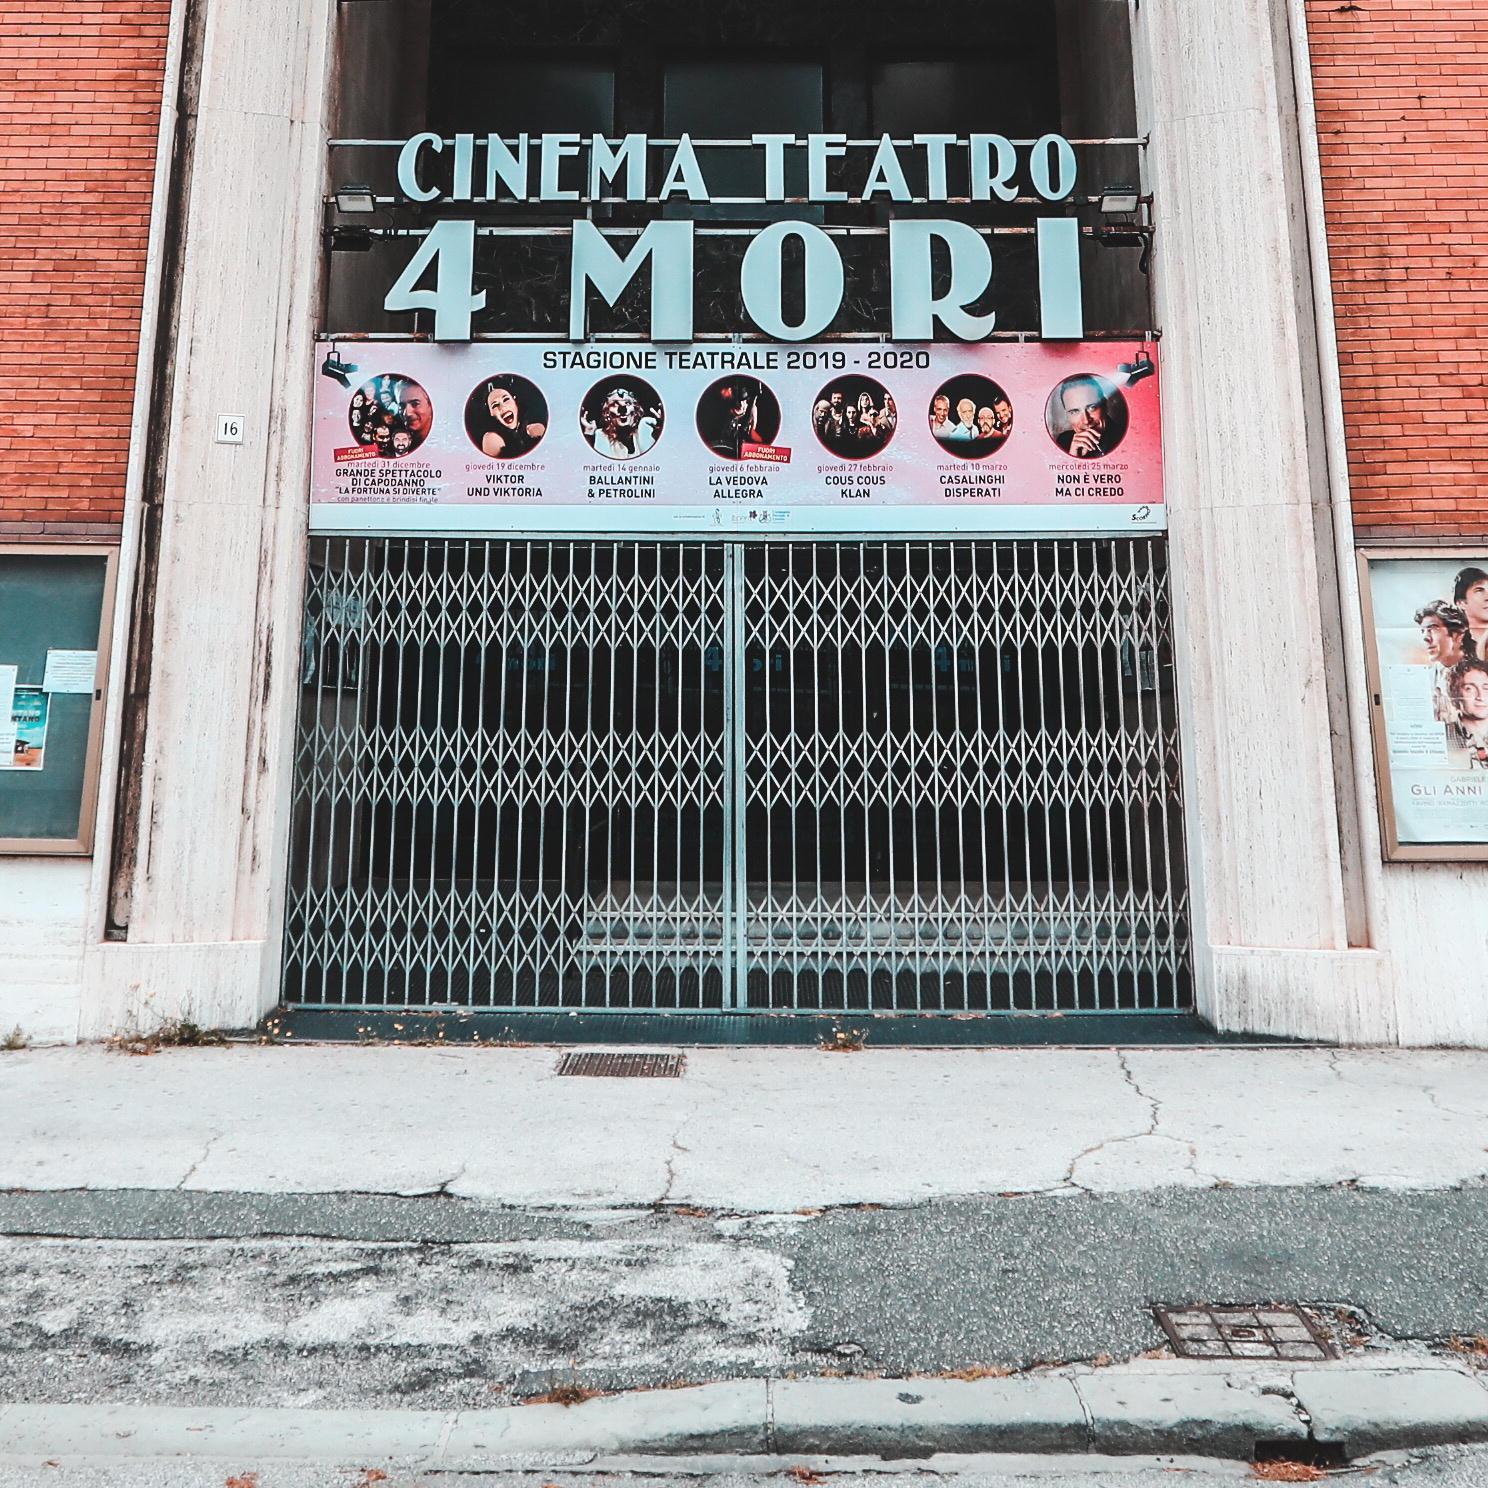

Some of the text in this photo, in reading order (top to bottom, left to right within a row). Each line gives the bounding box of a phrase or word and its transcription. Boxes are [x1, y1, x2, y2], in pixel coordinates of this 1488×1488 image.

[398, 132, 1077, 202] CINEMA TEATRO
[384, 217, 1083, 341] 4 MORI
[543, 350, 657, 369] STAGIONE
[664, 350, 779, 369] TEATRALE
[786, 350, 846, 369] 2019
[867, 350, 930, 369] 2020
[224, 421, 238, 436] 16
[756, 446, 776, 454] FUORI
[743, 451, 788, 462] ABBONAMENTO
[381, 461, 390, 469] 31
[393, 461, 431, 469] dicembre
[496, 463, 505, 471] 19
[507, 462, 545, 471] dicembre
[617, 464, 627, 472] 14
[628, 464, 661, 474] gennaio
[739, 464, 744, 472] 6
[746, 464, 780, 472] febbraio
[848, 464, 858, 472] 27
[859, 464, 894, 472] febbraio
[971, 463, 980, 471] 10
[1091, 462, 1101, 470] 25
[335, 469, 442, 479] GRANDE SPETTACOLO
[485, 474, 525, 484] VIKTOR
[1057, 472, 1121, 484] NON È VERO
[351, 478, 425, 487] DI CAPODANNO
[589, 476, 654, 486] BALLANTINI
[708, 476, 768, 486] LA VEDOVA
[825, 475, 886, 485] COUS COUS
[939, 475, 1005, 485] CASALINGHI
[351, 487, 391, 495] FORTUNA
[393, 487, 400, 495] SI
[467, 487, 543, 497] UND VIKTORIA
[587, 489, 656, 498] & PETROLINI
[713, 489, 764, 499] ALLEGRA
[841, 489, 870, 498] KLAN
[944, 488, 1001, 498] DISPERATI
[1055, 487, 1124, 497] MA CI CREDO
[351, 496, 385, 504] panettone
[1411, 784, 1437, 796] GLI
[1443, 784, 1482, 796] ANNI
